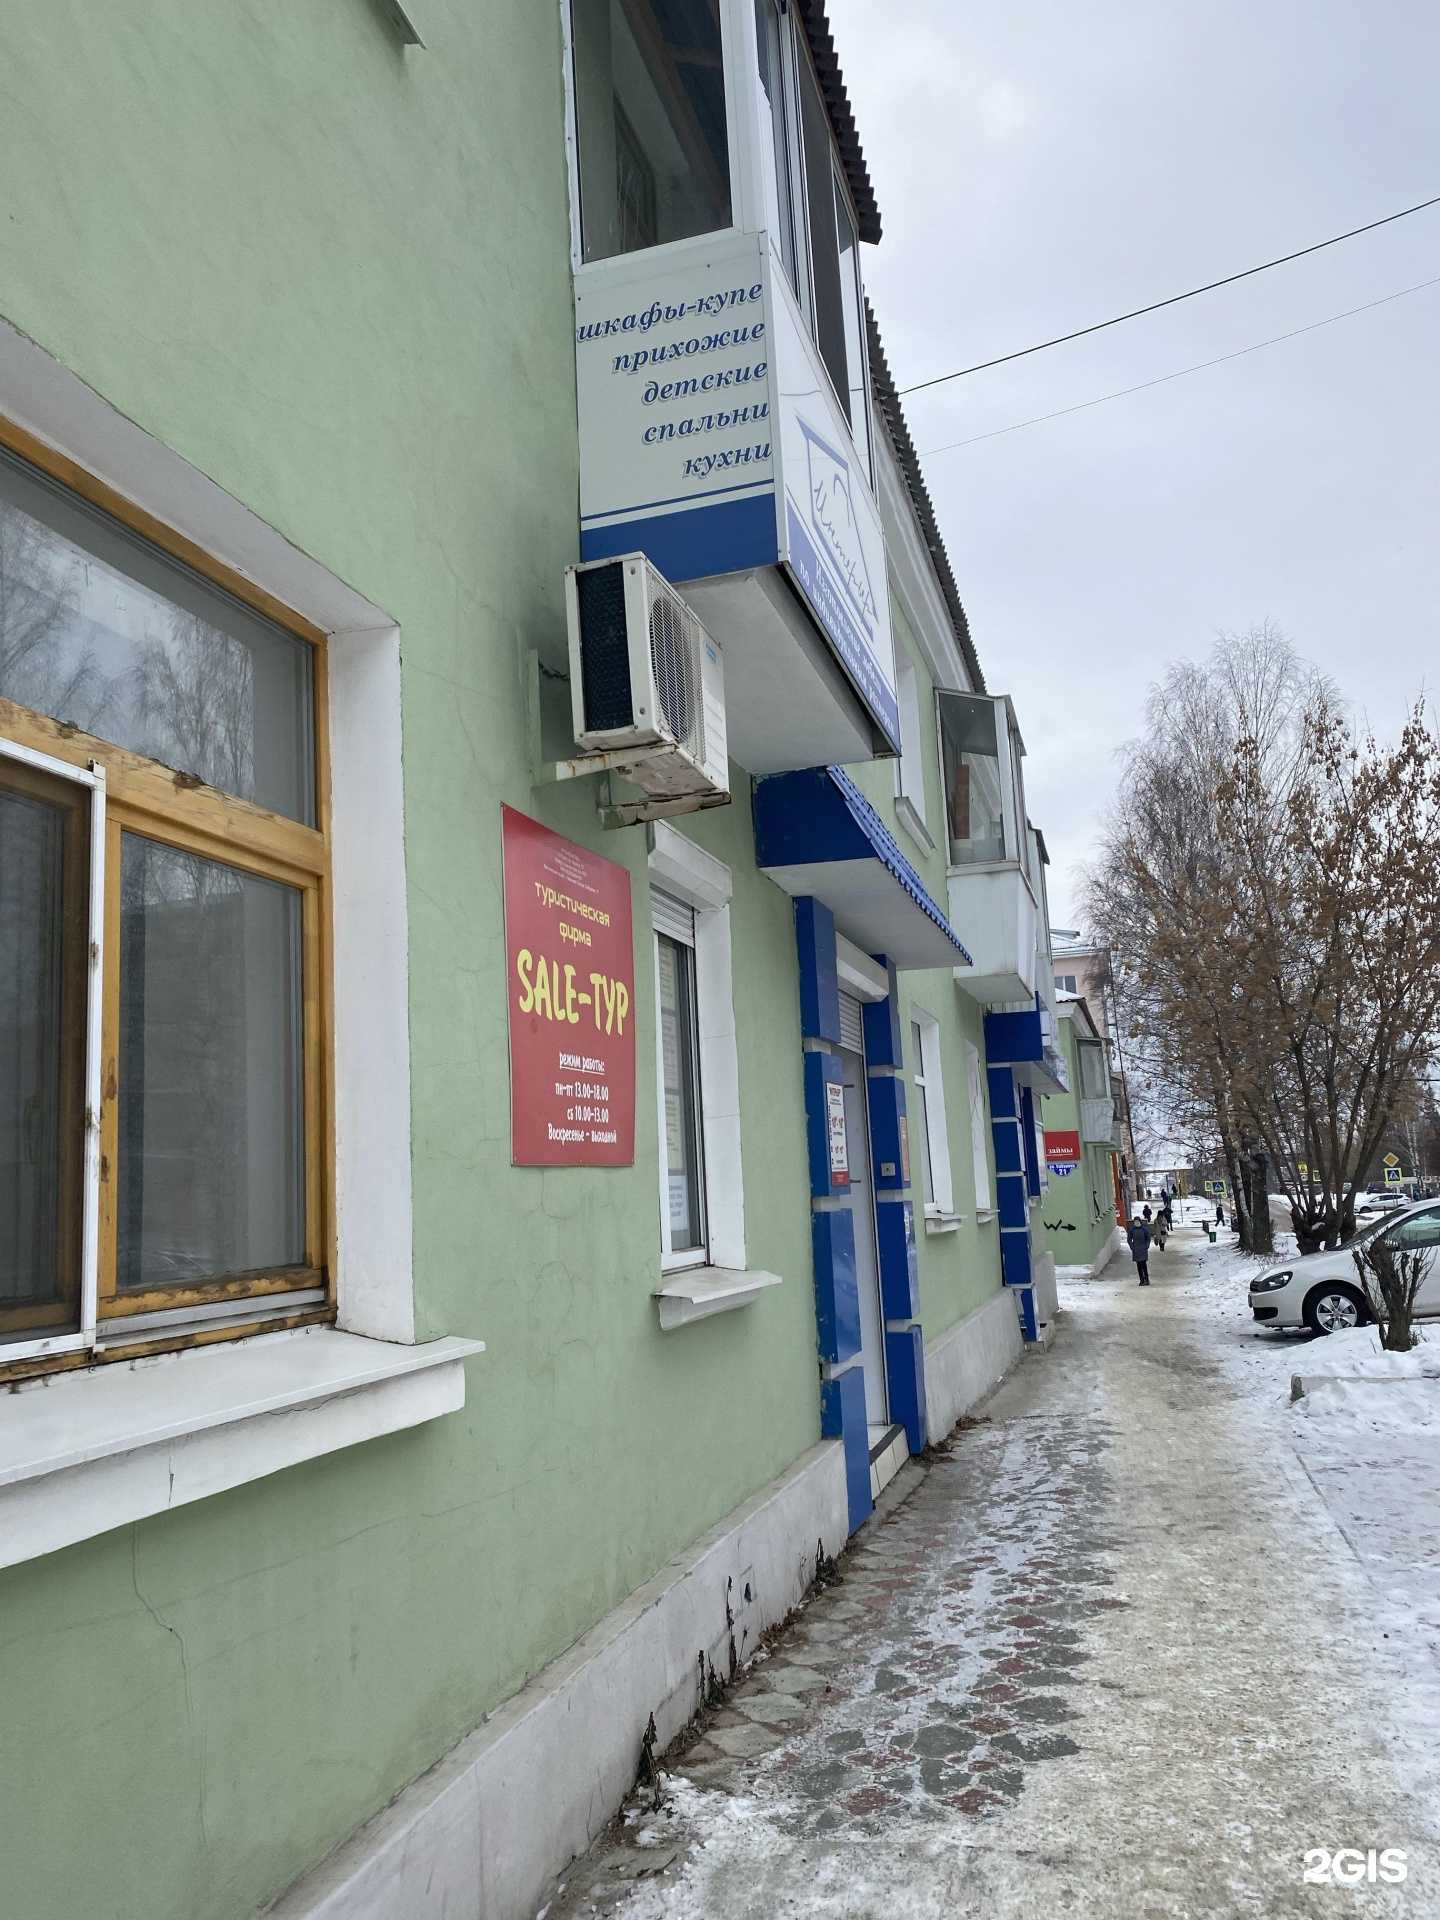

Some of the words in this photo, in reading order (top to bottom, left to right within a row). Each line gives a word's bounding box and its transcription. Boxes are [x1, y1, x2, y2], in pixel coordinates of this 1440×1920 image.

[577, 283, 763, 342] шкафы-купе
[613, 323, 766, 374] прихожие
[642, 362, 768, 406] детские
[642, 402, 770, 444] спальни
[683, 442, 772, 478] кухни
[534, 882, 611, 928] туристическая
[559, 921, 592, 947] фирма
[559, 1052, 581, 1069] режим
[582, 1056, 605, 1073] работы:
[555, 1082, 573, 1097] пн-пт
[567, 1106, 574, 1121] сб
[548, 1122, 585, 1146] Воскресенье
